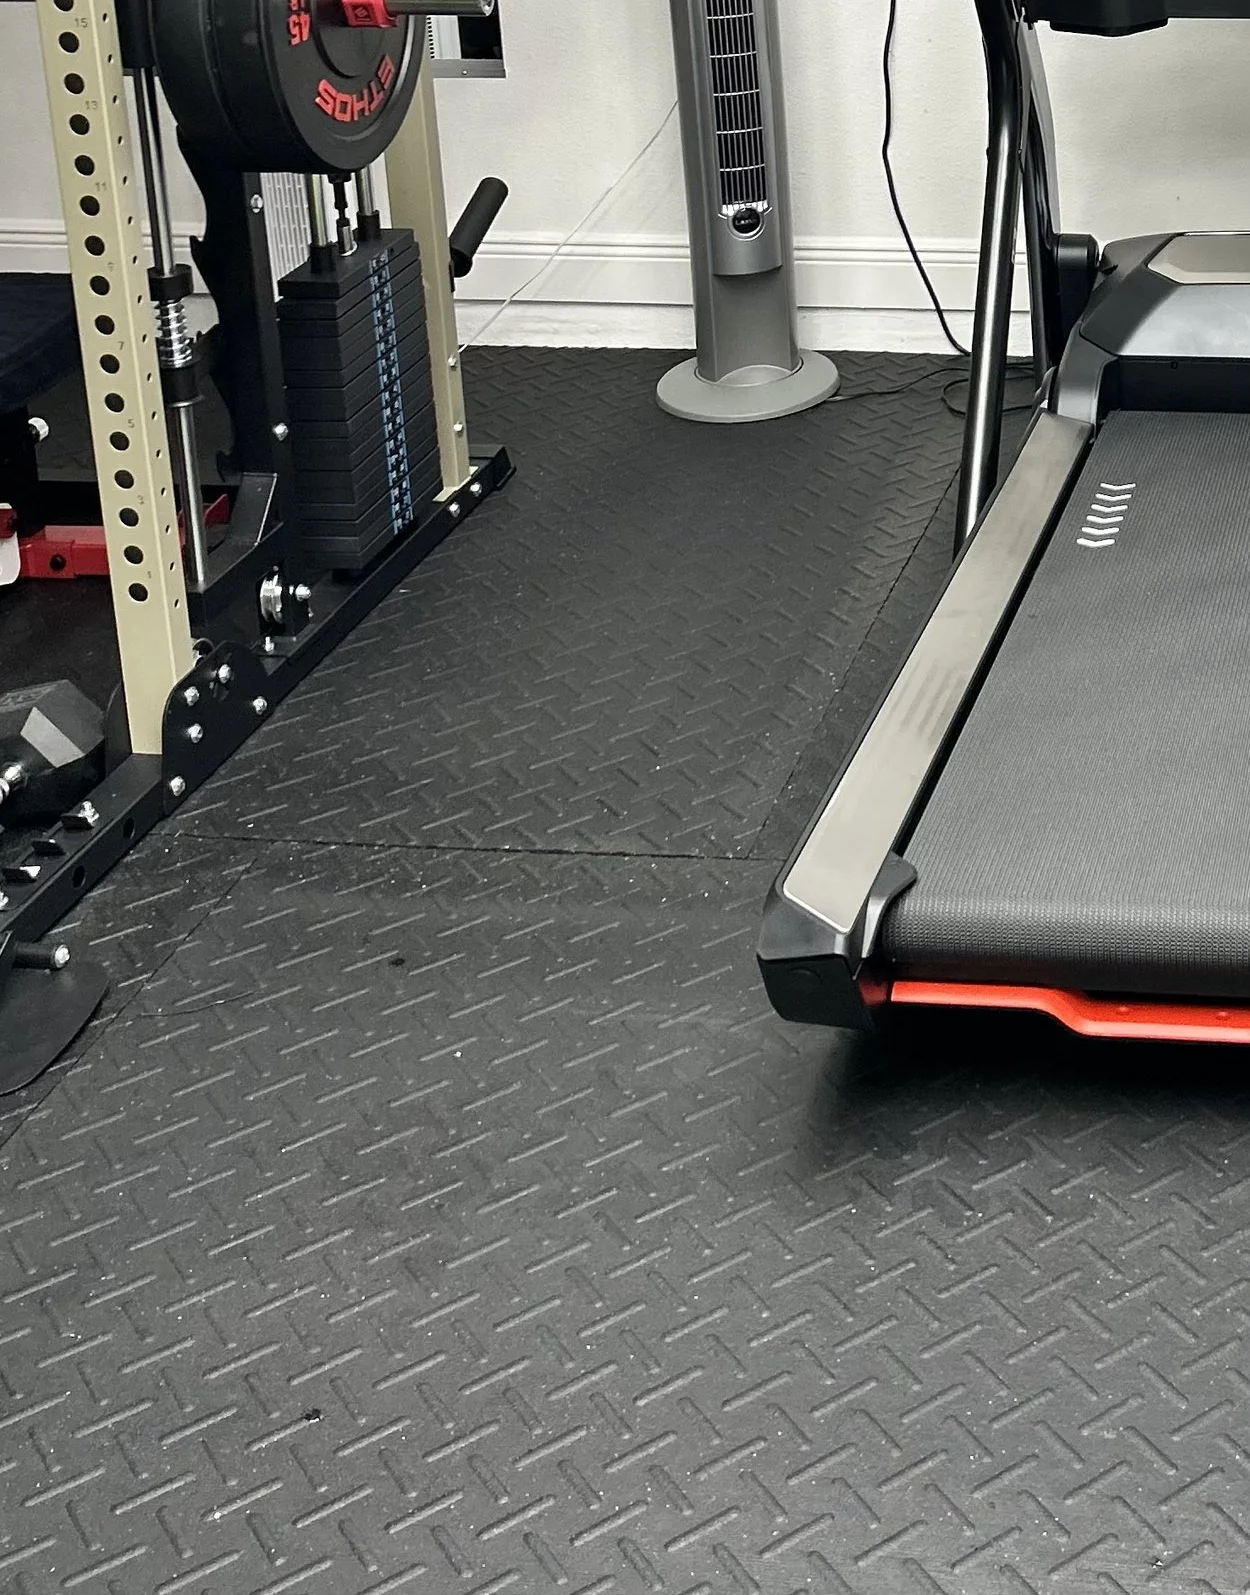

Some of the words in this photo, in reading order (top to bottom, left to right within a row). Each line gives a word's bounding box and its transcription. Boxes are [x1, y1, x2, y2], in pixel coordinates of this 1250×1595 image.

[75, 18, 88, 29] 15
[288, 10, 311, 46] 45
[315, 55, 395, 123] ETHOS
[118, 341, 125, 351] 7
[128, 419, 135, 429] 5
